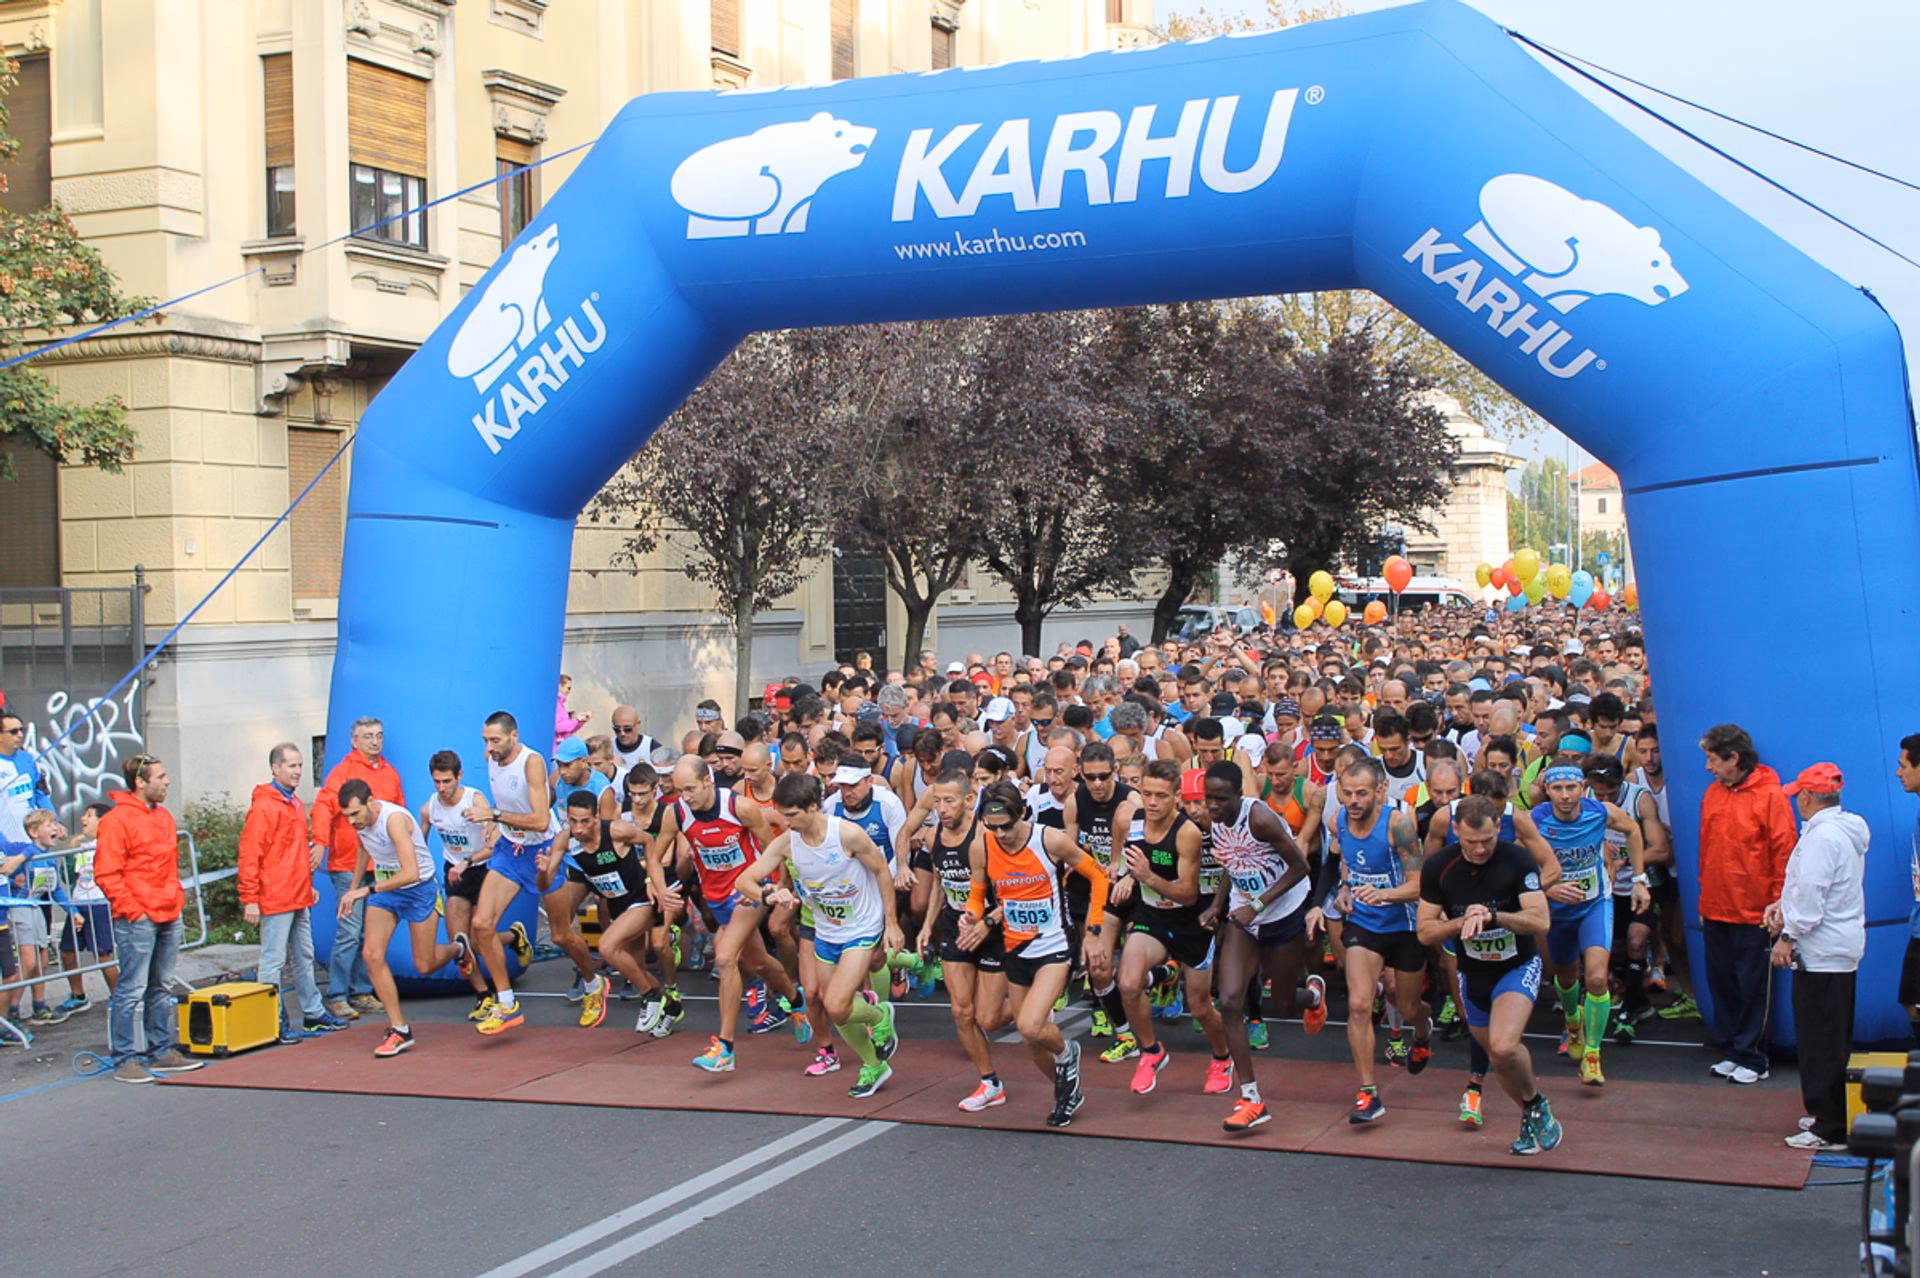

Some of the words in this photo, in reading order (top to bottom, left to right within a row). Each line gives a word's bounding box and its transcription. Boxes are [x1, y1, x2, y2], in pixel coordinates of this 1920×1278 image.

[892, 88, 1300, 222] KARHU
[894, 228, 1087, 260] www.karhu.com
[1402, 227, 1597, 379] KARHU
[472, 298, 607, 455] KARHU
[1356, 850, 1366, 865] S
[1008, 909, 1049, 924] 1503
[1472, 939, 1506, 952] 370
